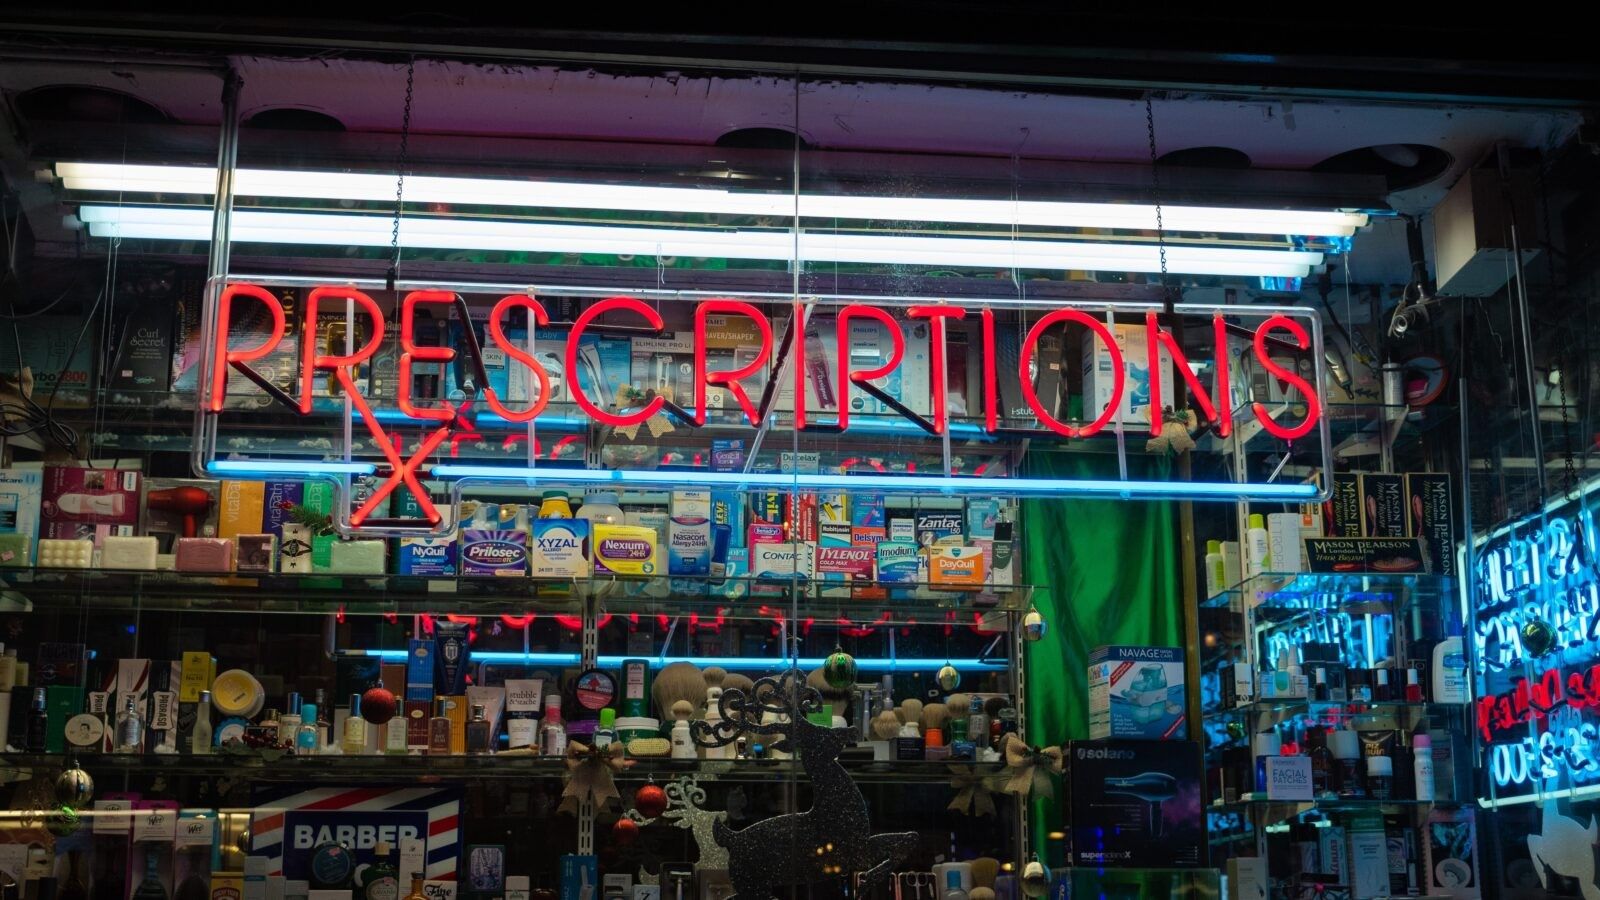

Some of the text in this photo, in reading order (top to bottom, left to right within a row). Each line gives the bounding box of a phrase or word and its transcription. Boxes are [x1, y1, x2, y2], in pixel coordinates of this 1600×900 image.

[137, 328, 160, 338] Curl
[704, 332, 755, 341] HAVER/SHAPER
[129, 337, 164, 347] Secret
[210, 282, 1320, 441] PRESCRIPTIONS
[1342, 481, 1357, 523] MASON
[1385, 482, 1400, 524] MASON
[918, 517, 961, 528] Zantac
[1432, 481, 1450, 576] MASON PEARSON
[538, 538, 579, 548] XYZAL
[854, 533, 884, 543] Delsym
[605, 540, 646, 550] Nexium
[672, 540, 691, 548] Allergy
[1314, 541, 1410, 554] MASON PEARSON
[412, 546, 446, 558] NyQuil
[469, 546, 521, 558] Prilosec
[762, 551, 803, 560] CONTAC
[819, 549, 870, 561] TYLENOL
[880, 546, 915, 557] Imodium
[939, 559, 975, 569] DayQuil
[158, 694, 168, 727] PRORASO
[1086, 748, 1135, 760] solano
[1272, 768, 1308, 778] FACIAL
[1272, 777, 1308, 785] PATCHES
[293, 824, 418, 850] BARBER
[424, 883, 453, 898] Fine
